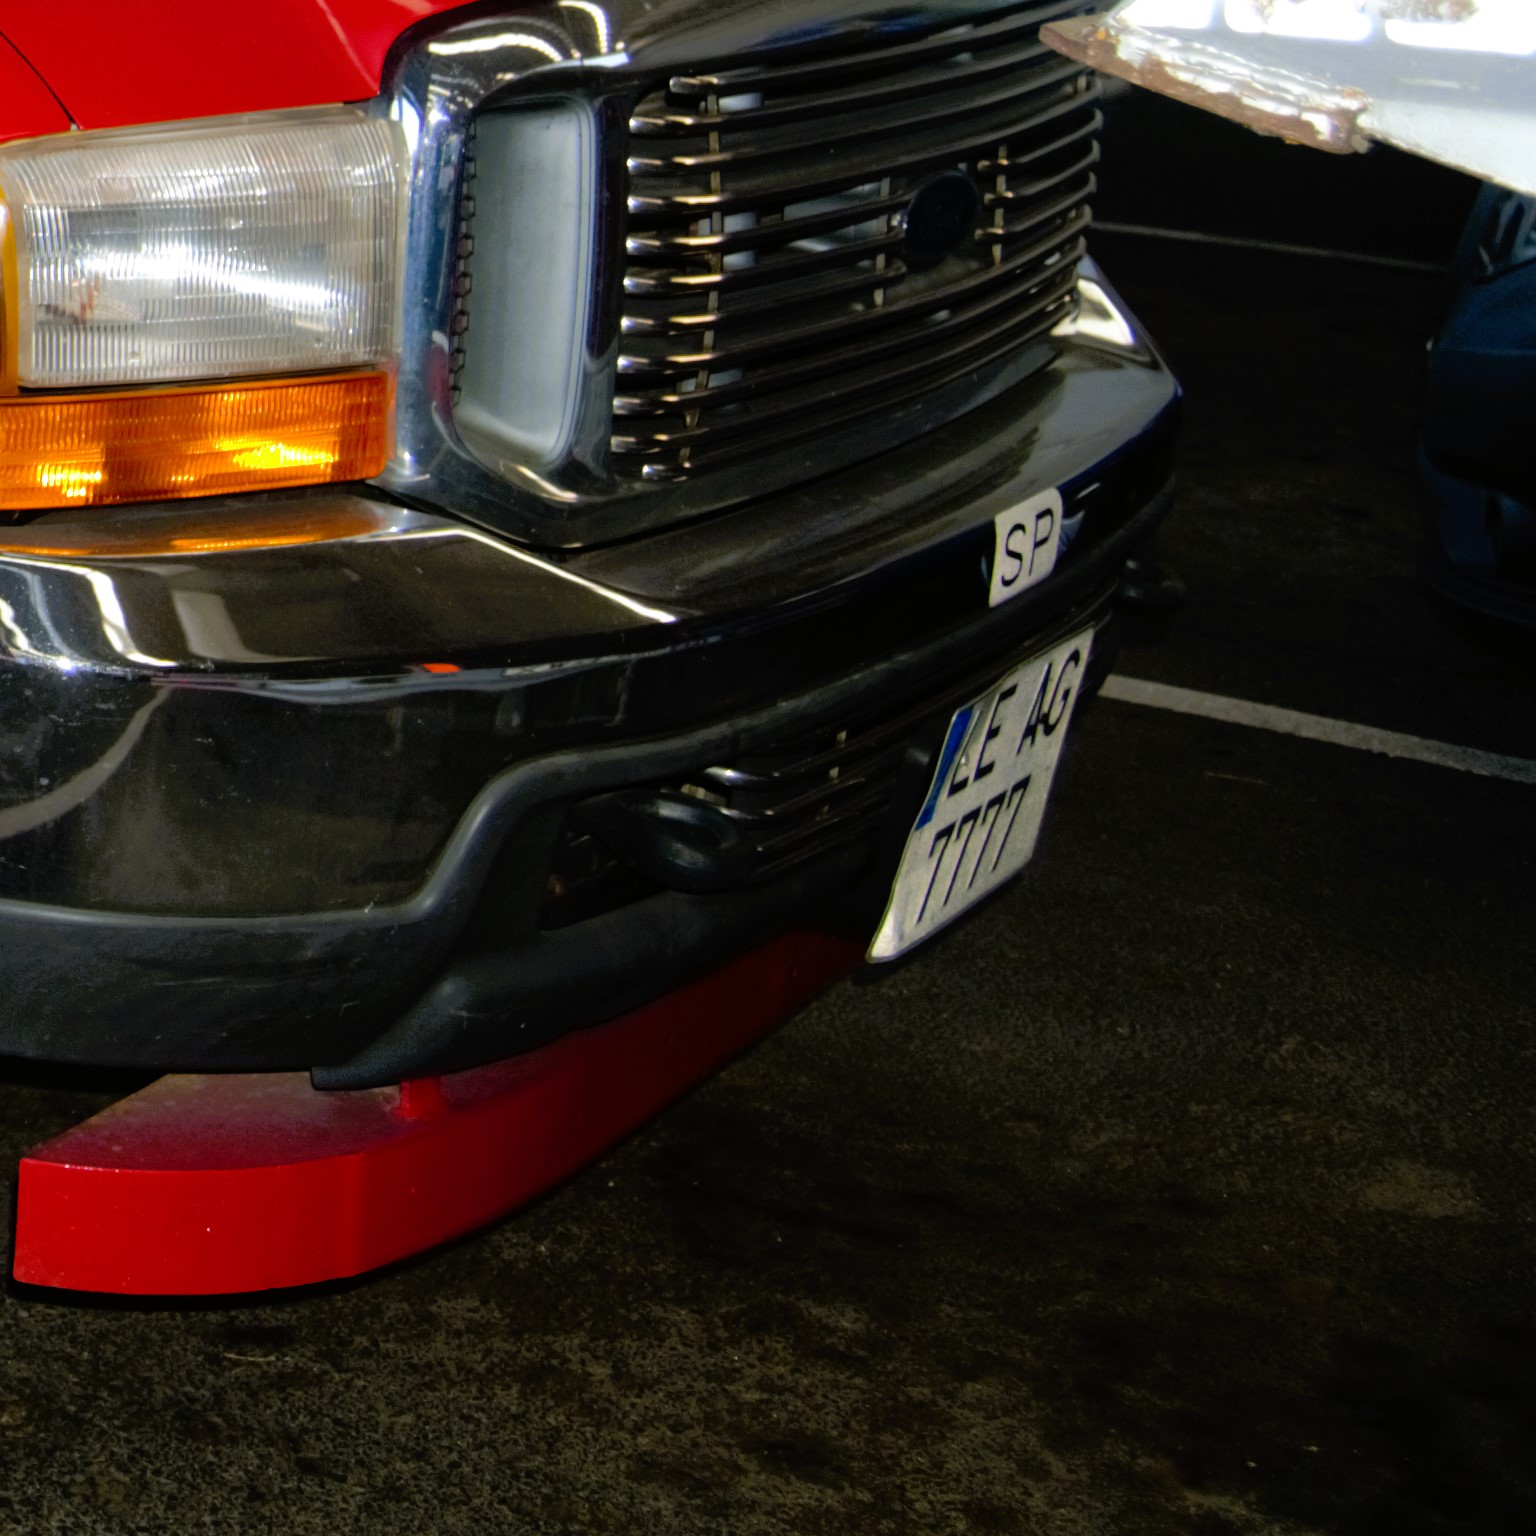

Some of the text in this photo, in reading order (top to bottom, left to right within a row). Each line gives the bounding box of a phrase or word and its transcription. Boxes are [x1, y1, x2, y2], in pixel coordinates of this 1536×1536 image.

[1001, 507, 1054, 588] SP
[946, 648, 1080, 799] LE AG
[916, 775, 1031, 924] 7777
